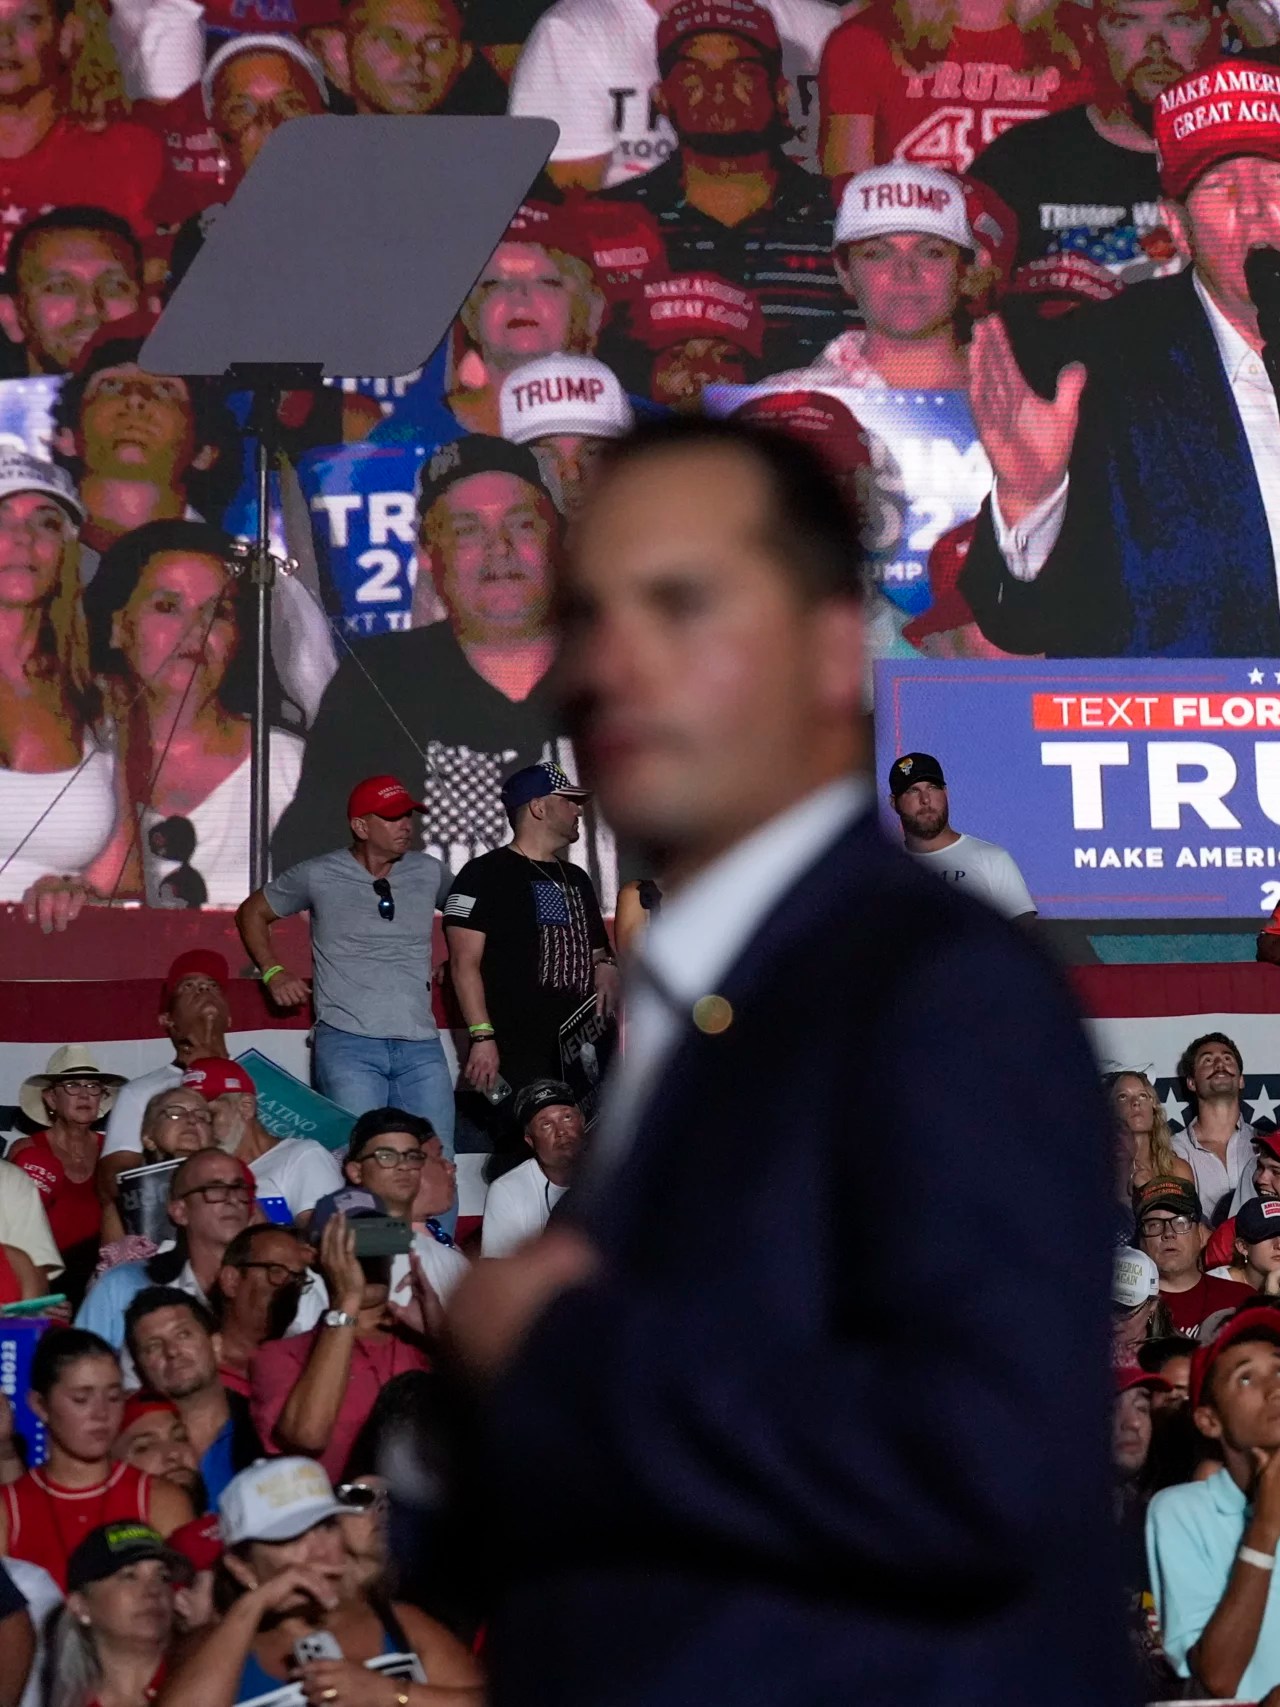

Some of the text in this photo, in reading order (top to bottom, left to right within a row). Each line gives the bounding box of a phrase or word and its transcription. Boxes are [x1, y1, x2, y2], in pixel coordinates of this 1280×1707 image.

[902, 61, 1060, 102] TRUMP
[1160, 75, 1211, 115] MAKE
[1173, 102, 1232, 140] GREAT
[859, 183, 950, 213] TRUMP
[511, 376, 606, 412] TRUMP
[1052, 697, 1159, 727] TEXT
[1074, 847, 1165, 868] MAKE
[256, 1091, 318, 1132] LATINO
[1115, 1259, 1143, 1277] MERICA
[0, 1339, 18, 1396] 88022
